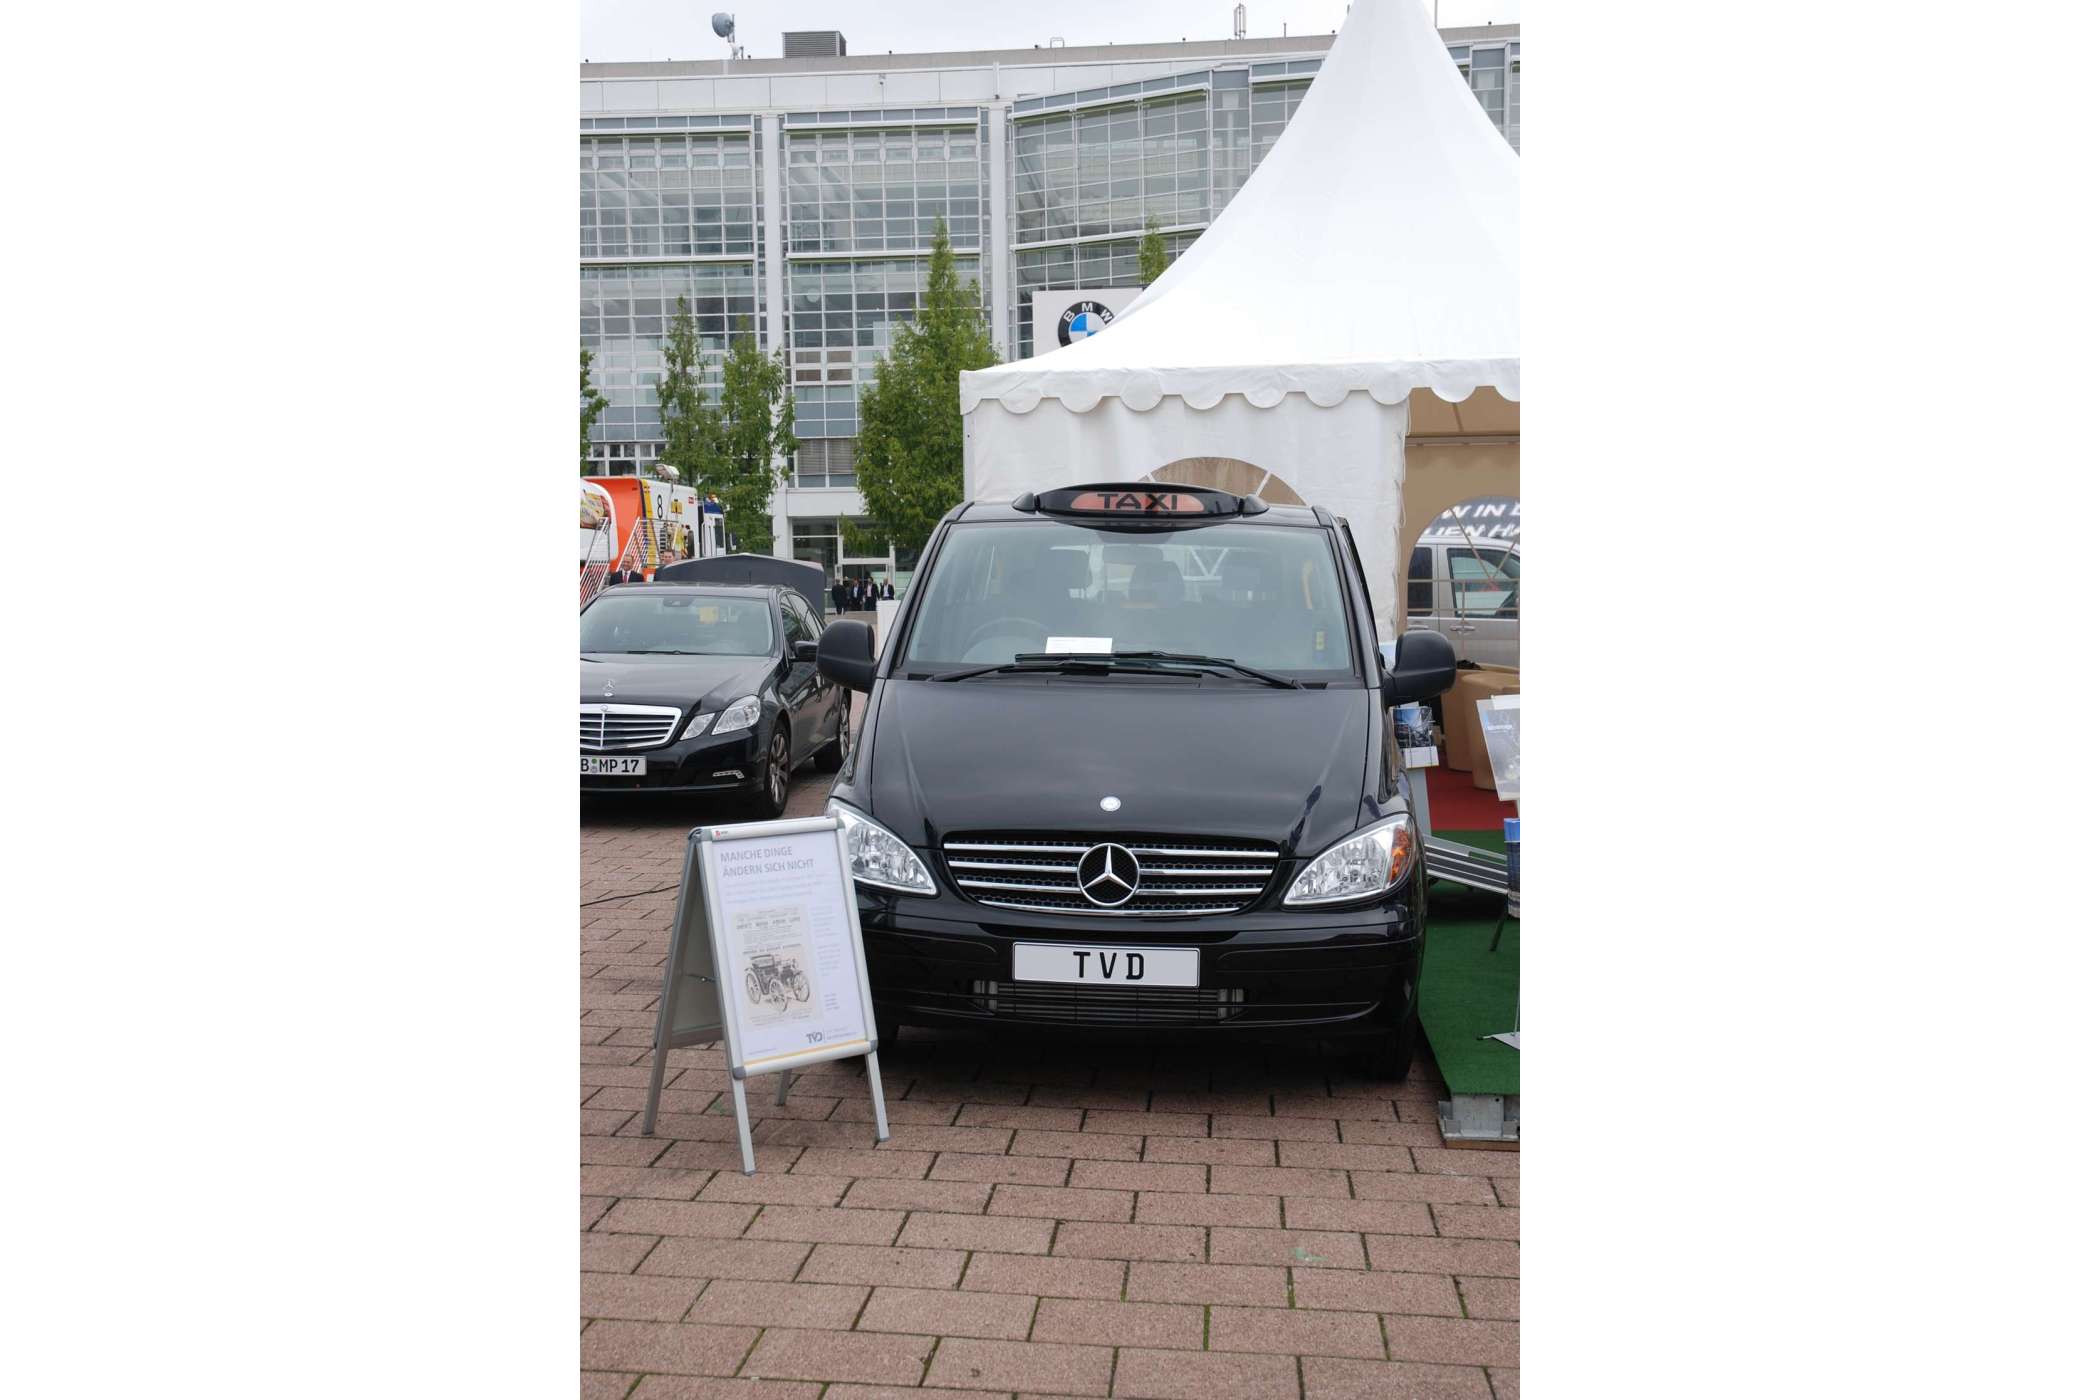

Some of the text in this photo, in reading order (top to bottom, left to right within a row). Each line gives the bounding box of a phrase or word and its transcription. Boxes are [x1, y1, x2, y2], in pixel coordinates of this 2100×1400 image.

[1063, 302, 1112, 322] BMW
[1097, 493, 1178, 510] TAXI
[1473, 504, 1506, 517] IN
[580, 758, 640, 773] B MP 17
[720, 846, 792, 862] MANCHE DINGE
[723, 858, 815, 877] ÄNDERN SICH NICHT
